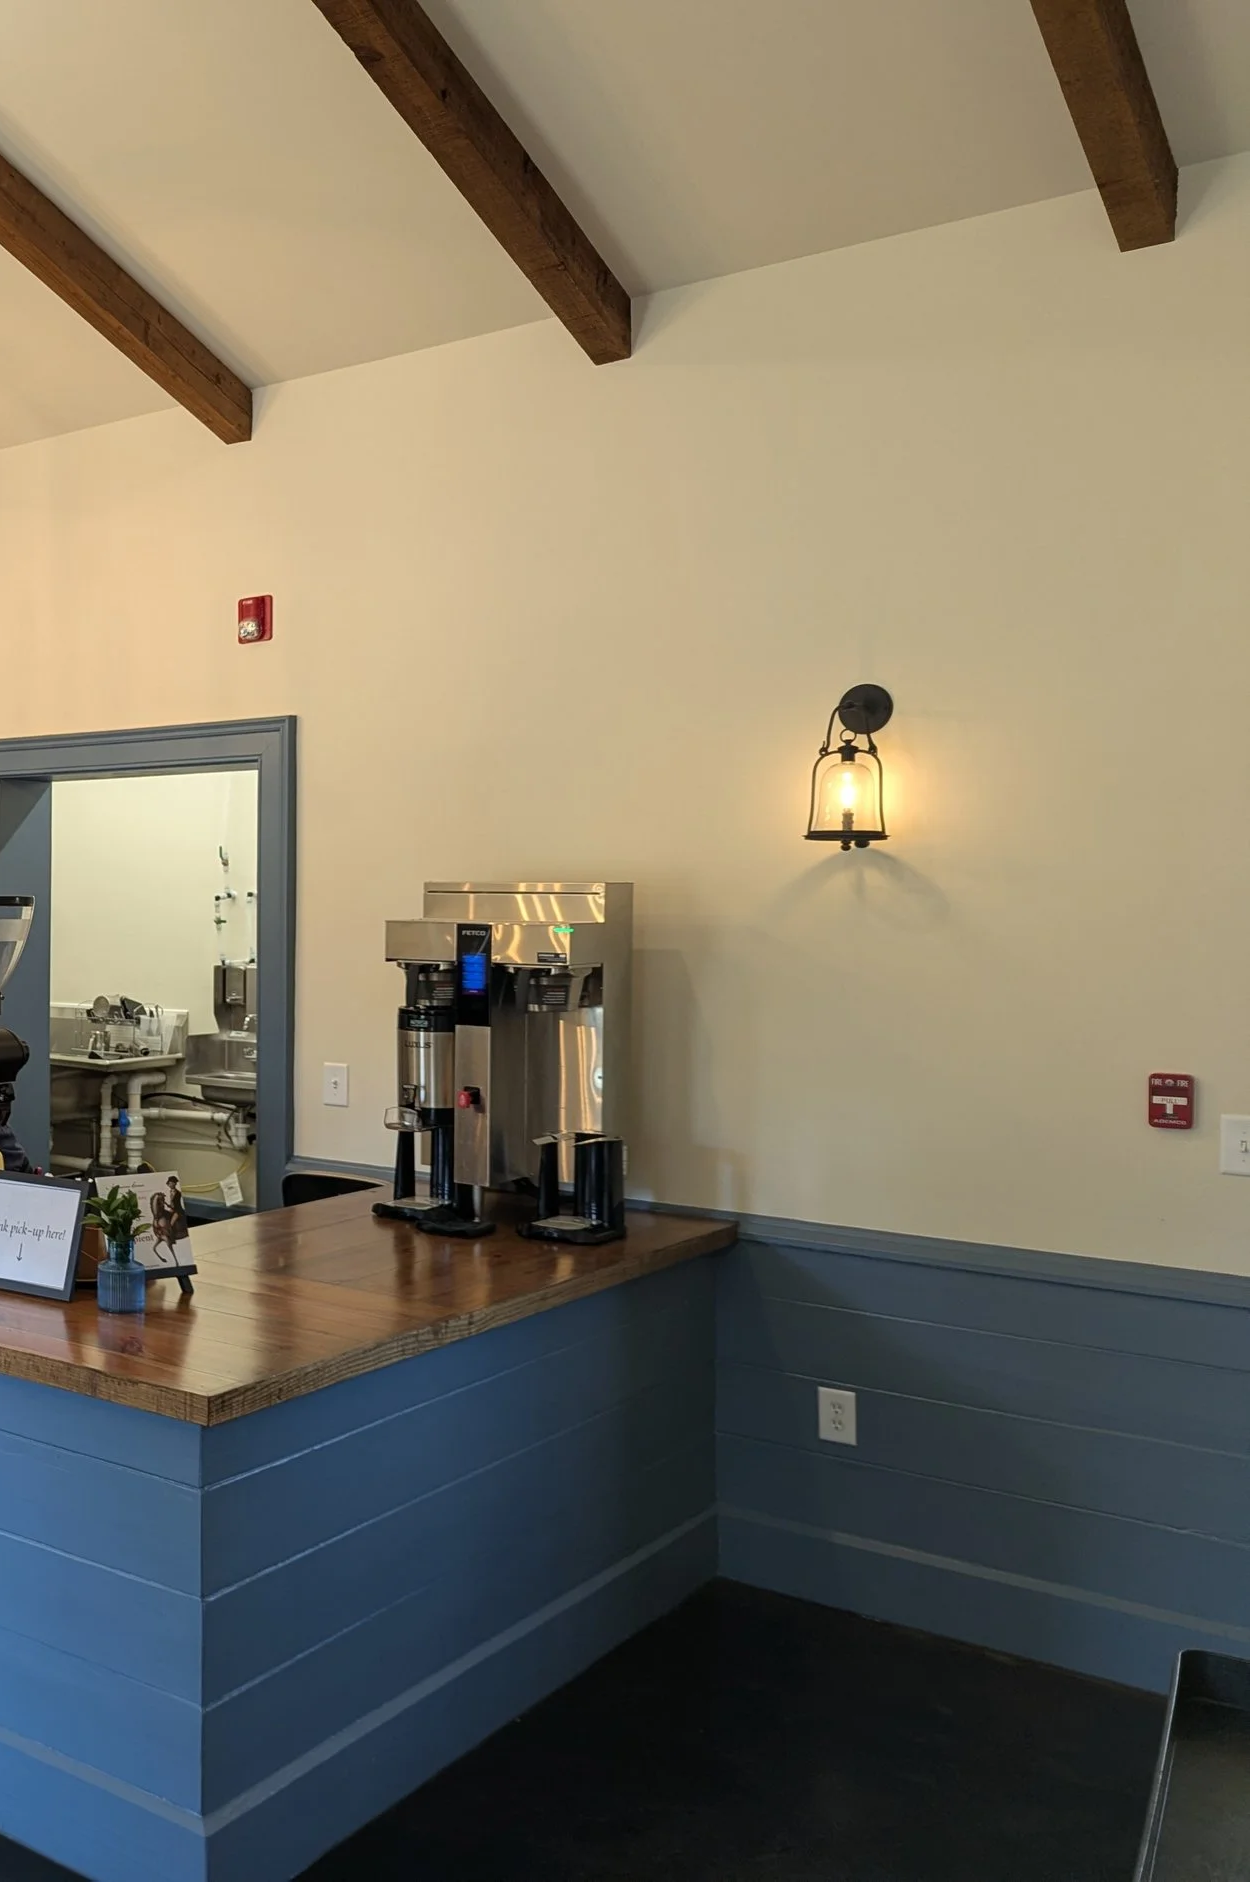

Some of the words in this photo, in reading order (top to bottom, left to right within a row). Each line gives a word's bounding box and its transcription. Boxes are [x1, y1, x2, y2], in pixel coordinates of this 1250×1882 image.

[1151, 1078, 1163, 1086] FIRE
[9, 1221, 45, 1242] pick-up
[45, 1225, 67, 1241] here!
